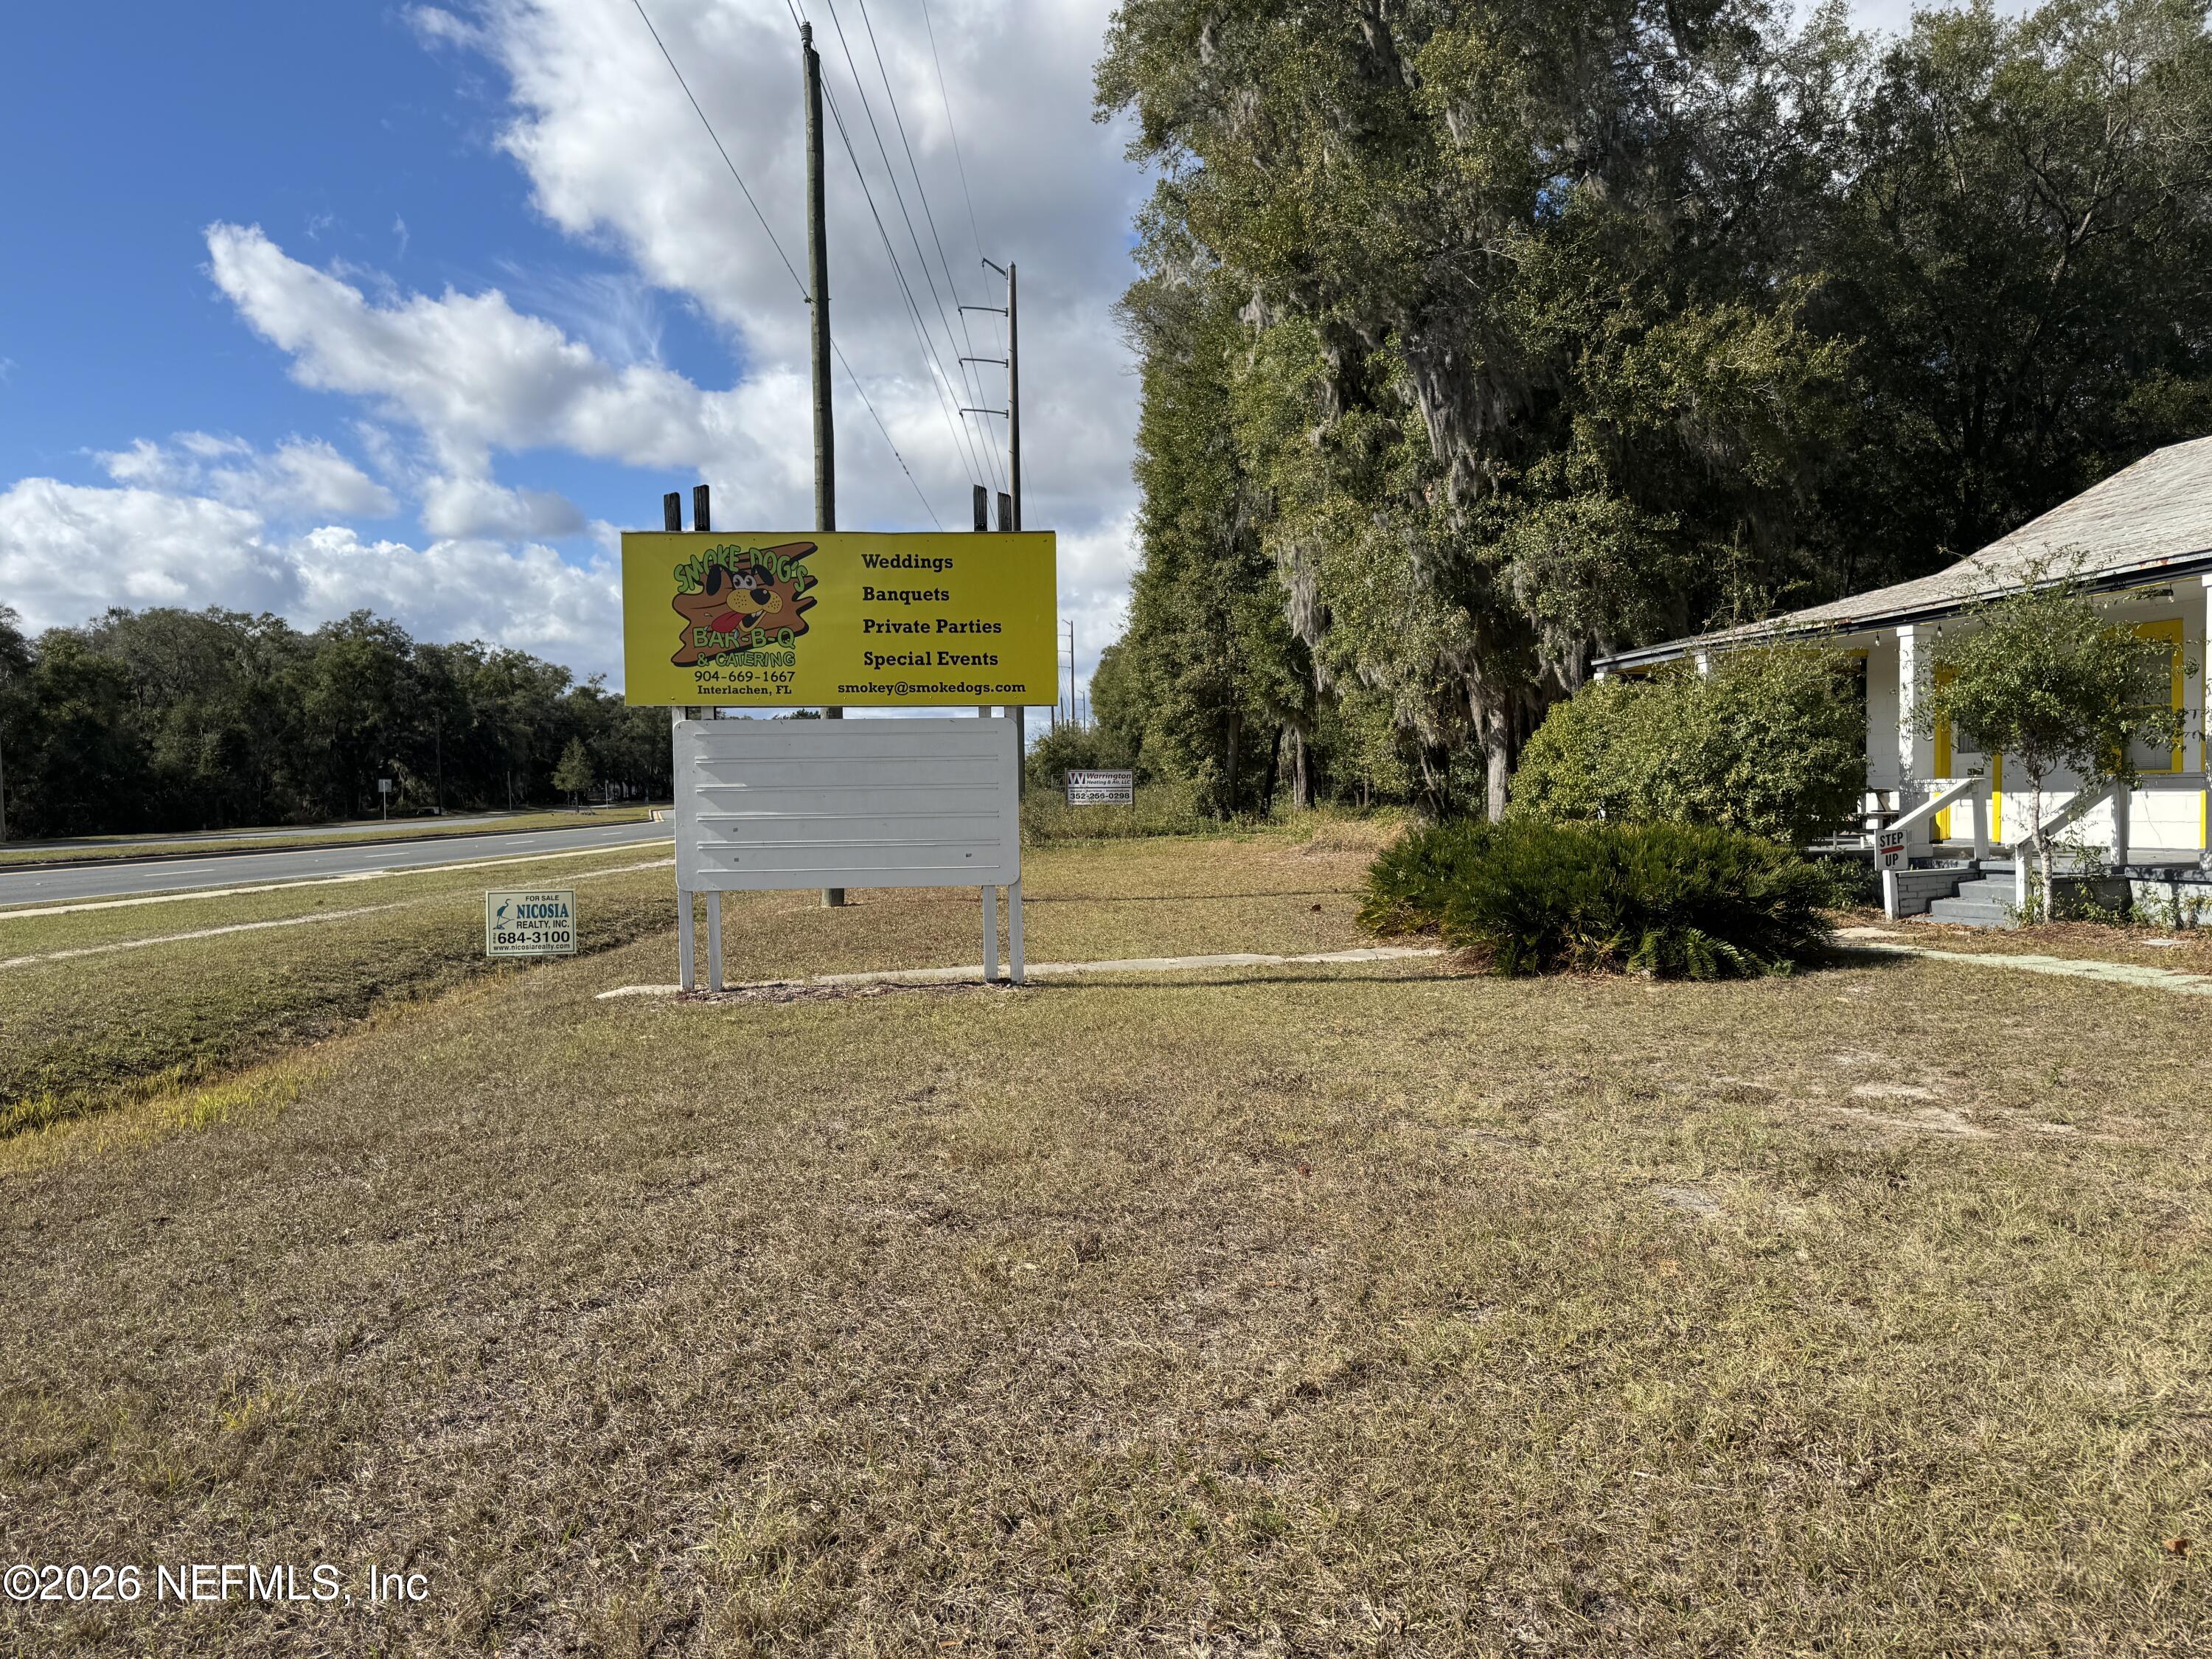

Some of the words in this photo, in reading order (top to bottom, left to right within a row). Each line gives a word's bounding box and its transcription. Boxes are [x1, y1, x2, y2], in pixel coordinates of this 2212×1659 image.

[673, 544, 741, 593] SMOKE
[749, 548, 808, 592] DOG'S
[861, 554, 953, 572] Weddings
[862, 586, 950, 605] Banquets
[863, 619, 931, 633] Private
[936, 619, 1002, 633] Parties
[692, 627, 796, 650] BAR-B-Q
[697, 652, 709, 667] &
[715, 651, 796, 667] CATERING
[863, 651, 932, 669] Special
[937, 652, 998, 666] Events
[695, 671, 796, 682] 904-669-1667
[698, 685, 773, 696] Interlachen,
[776, 686, 792, 695] FL
[838, 681, 1026, 695] smokey@smokedogs.com
[1087, 773, 1131, 781] Warrington
[1879, 832, 1903, 847] STEP
[1885, 853, 1899, 866] UP
[516, 903, 569, 919] NICOSIA
[516, 920, 551, 929] REALTY,
[498, 931, 570, 944] 684-3100
